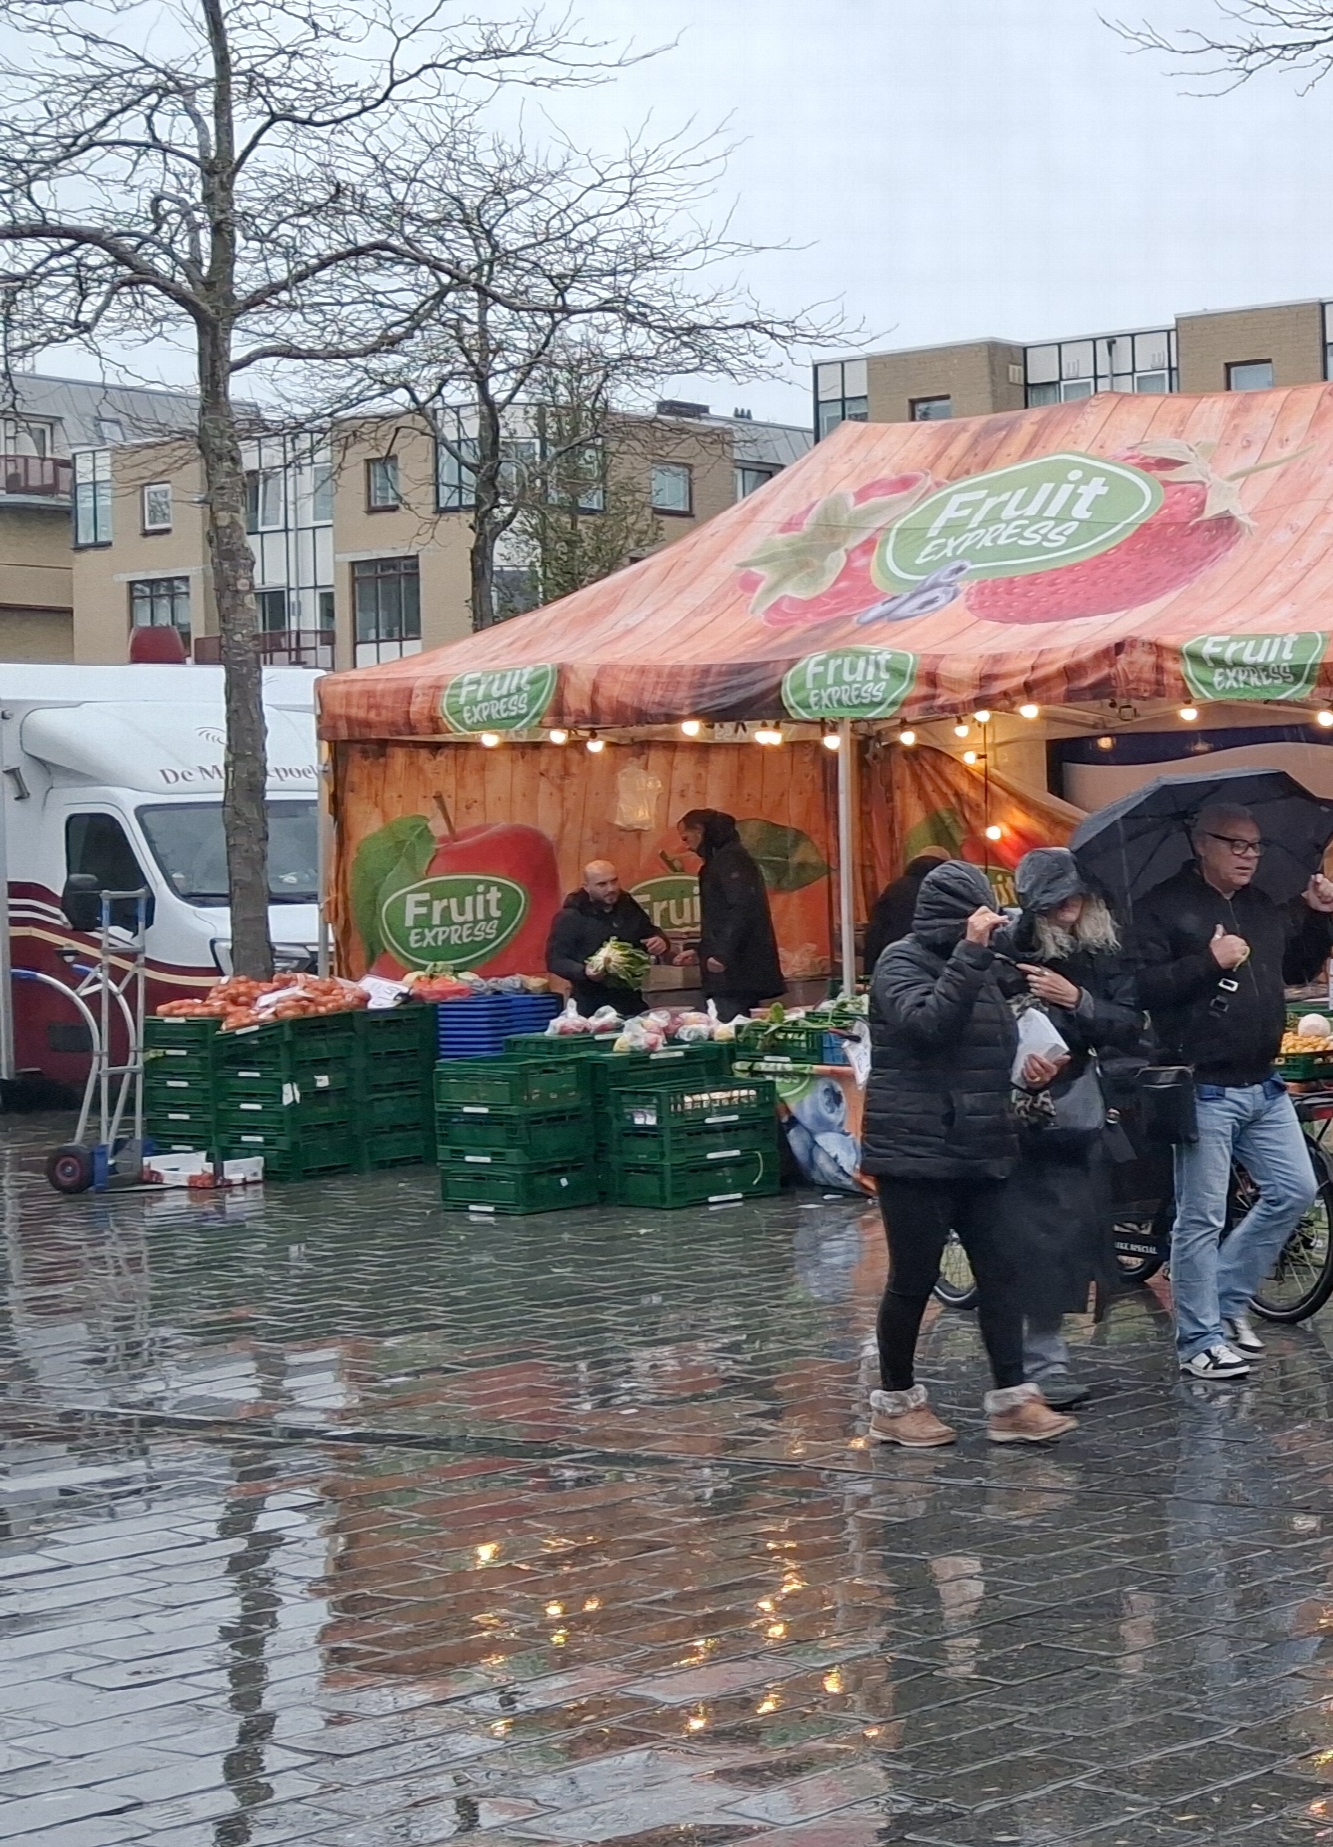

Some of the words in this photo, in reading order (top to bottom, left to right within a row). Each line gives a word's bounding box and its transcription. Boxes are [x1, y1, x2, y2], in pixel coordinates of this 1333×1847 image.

[926, 469, 1109, 538] Fruit
[914, 519, 1080, 565] EXPRESS
[1202, 633, 1299, 667] Fruit
[459, 666, 535, 705] Fruit
[805, 650, 892, 689] Fruit
[1212, 662, 1295, 691] EXPRESS
[463, 692, 528, 725] EXPRESS
[809, 681, 887, 711] EXPRESS
[159, 766, 195, 785] De
[405, 884, 502, 927] Fruit
[408, 919, 499, 949] EXPRESS
